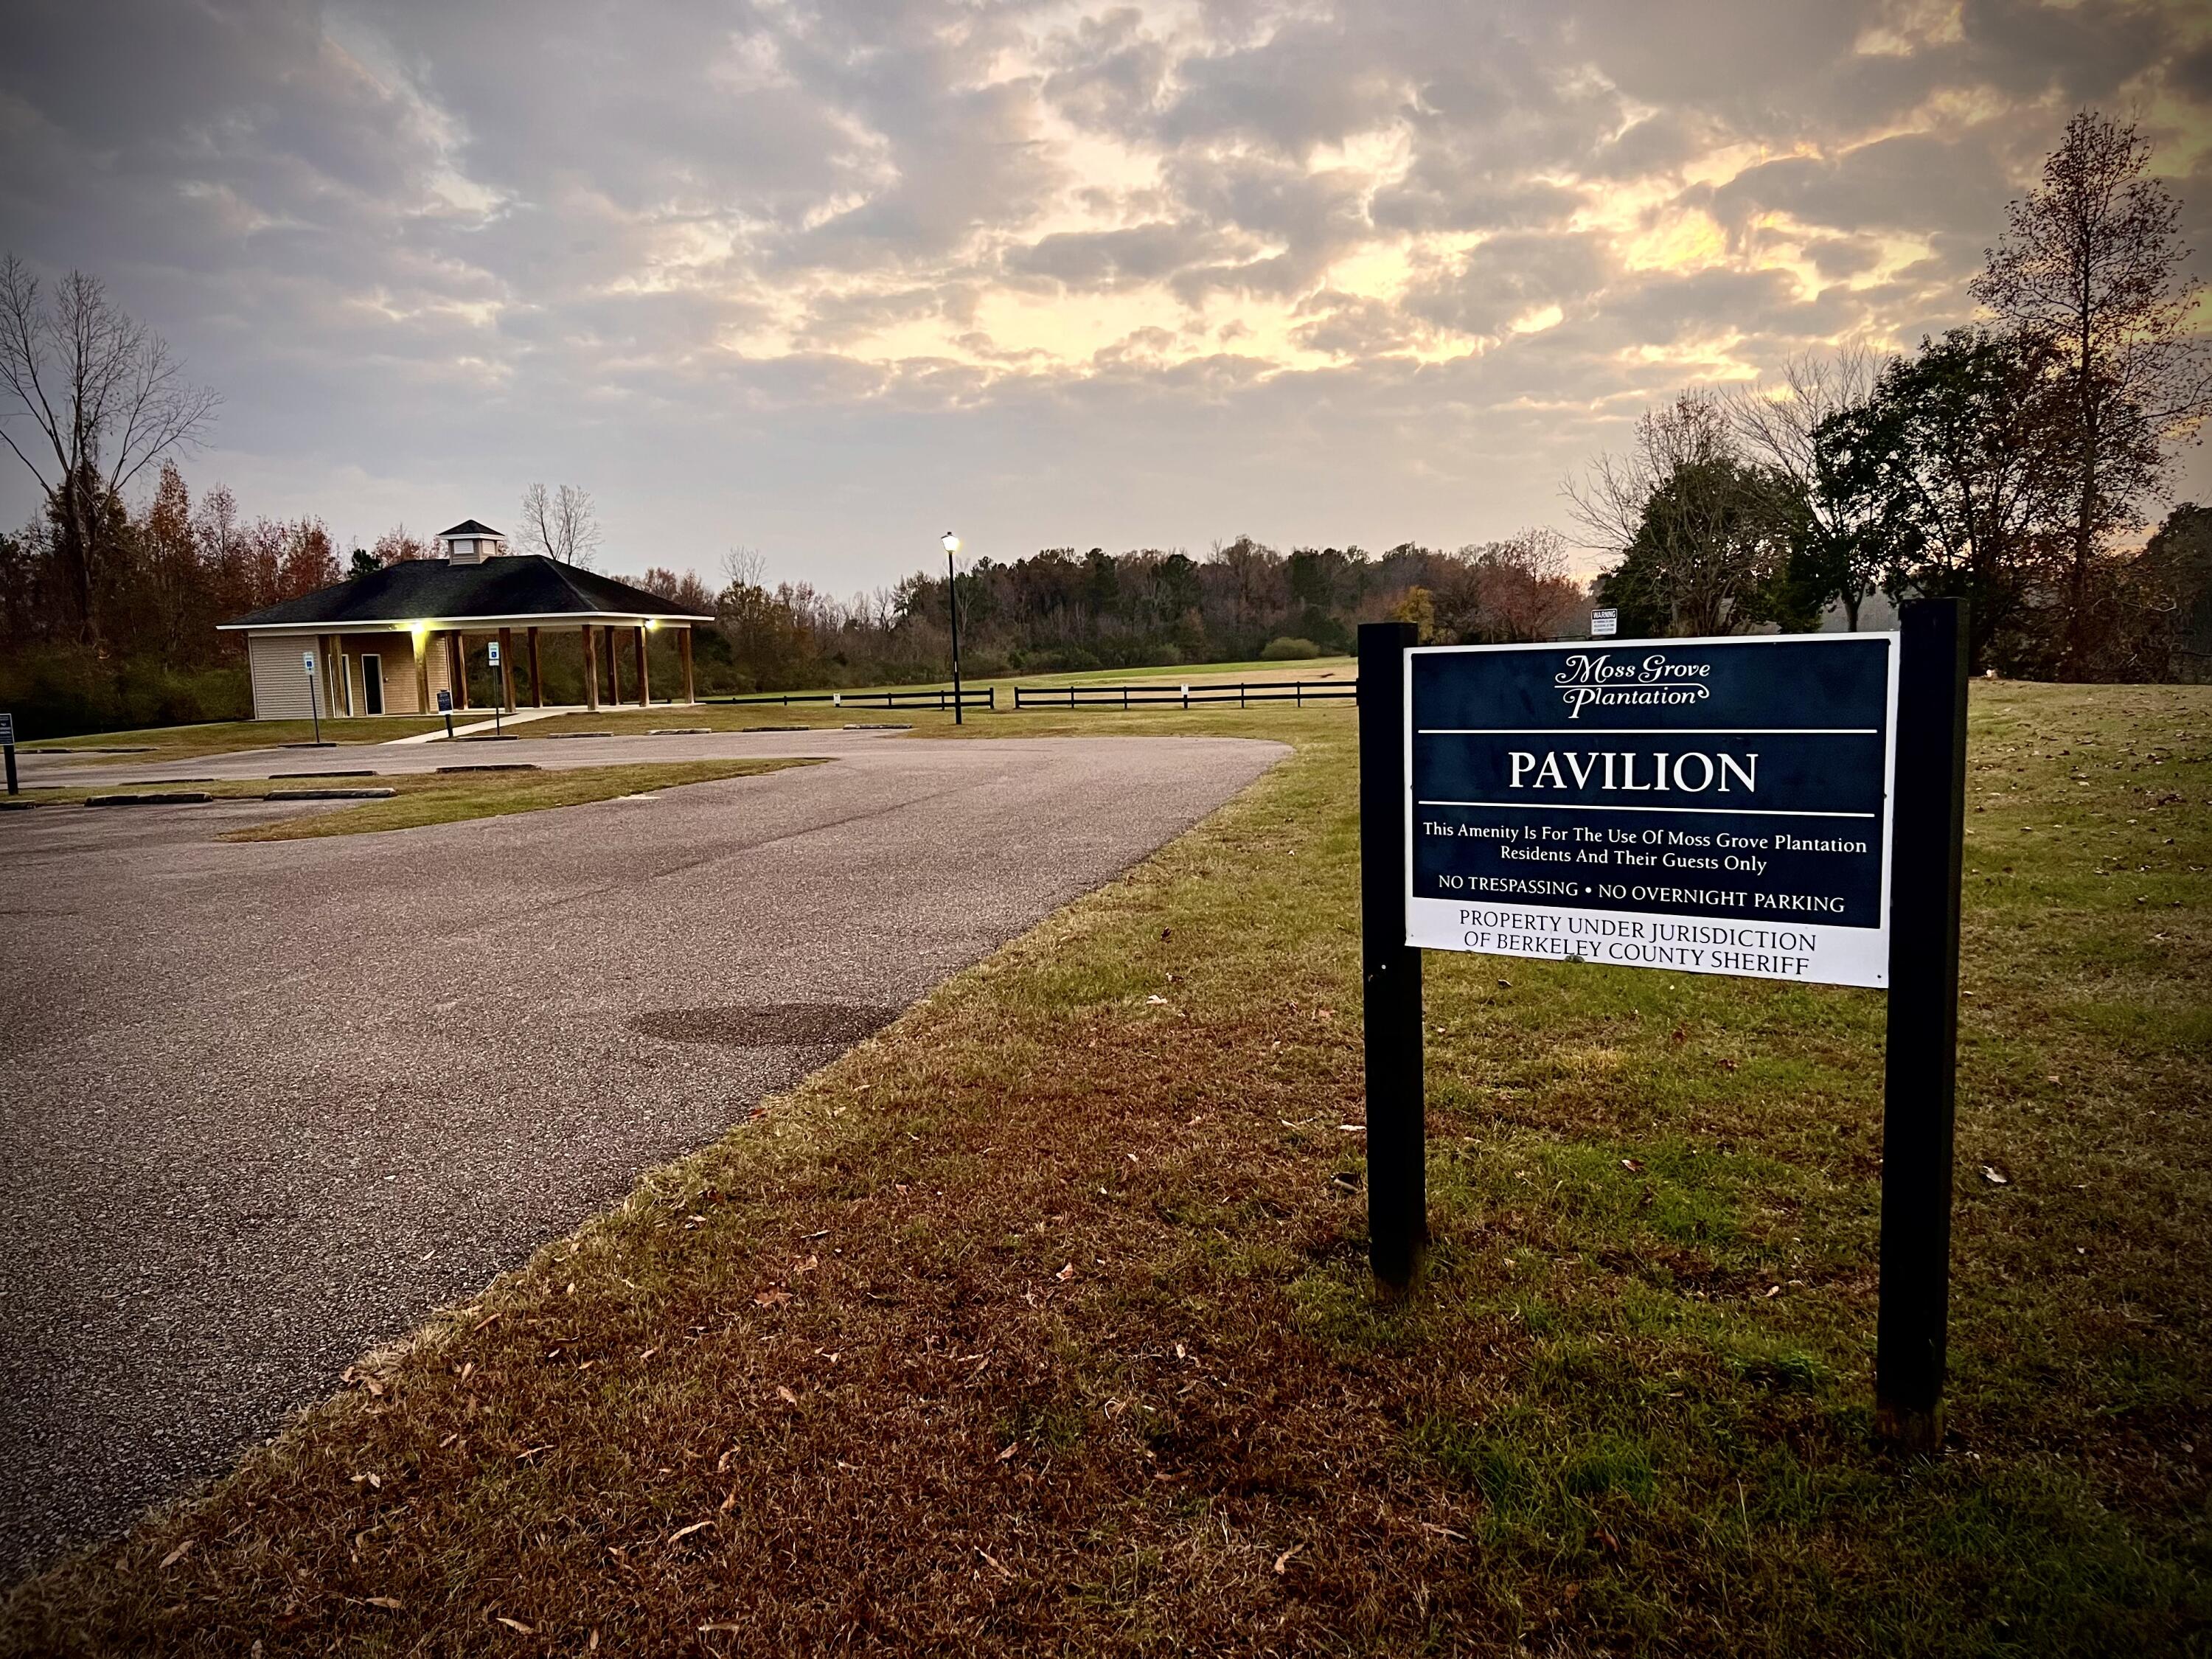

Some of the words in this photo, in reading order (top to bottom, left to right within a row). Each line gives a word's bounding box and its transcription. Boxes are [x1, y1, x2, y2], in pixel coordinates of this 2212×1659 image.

[1593, 611, 1616, 619] WARNING
[1555, 655, 1635, 684] Moss
[1638, 655, 1711, 683] Grove
[1562, 686, 1697, 719] Plantation
[1509, 751, 1759, 793] PAVILION
[1423, 822, 1454, 836] This
[1458, 824, 1519, 843] Amenity
[1524, 826, 1537, 840] Is
[1542, 827, 1568, 841] For
[1573, 827, 1603, 843] The
[1608, 829, 1637, 844] Use
[1642, 830, 1664, 845] Of
[1668, 831, 1711, 847] Moss
[1717, 832, 1769, 849] Grove
[1775, 834, 1867, 853] Plantation
[1500, 846, 1571, 863] Residents
[1576, 849, 1608, 864] And
[1613, 850, 1658, 866] Their
[1662, 852, 1719, 870] Guests
[1724, 855, 1767, 876] Only
[1439, 875, 1464, 889] NO
[1467, 876, 1579, 897] TRESPASSING
[1599, 884, 1627, 900] NO
[1632, 886, 1748, 907] OVERNIGHT
[1754, 893, 1845, 913] PARKING
[1459, 909, 1562, 932] PROPERTY
[1568, 917, 1646, 939] UNDER
[1649, 923, 1817, 952] JURISDICTION
[1464, 931, 1492, 947] OF
[1497, 933, 1602, 957] BERKELEY
[1608, 942, 1705, 967] COUNTY
[1711, 950, 1810, 975] SHERIFF
